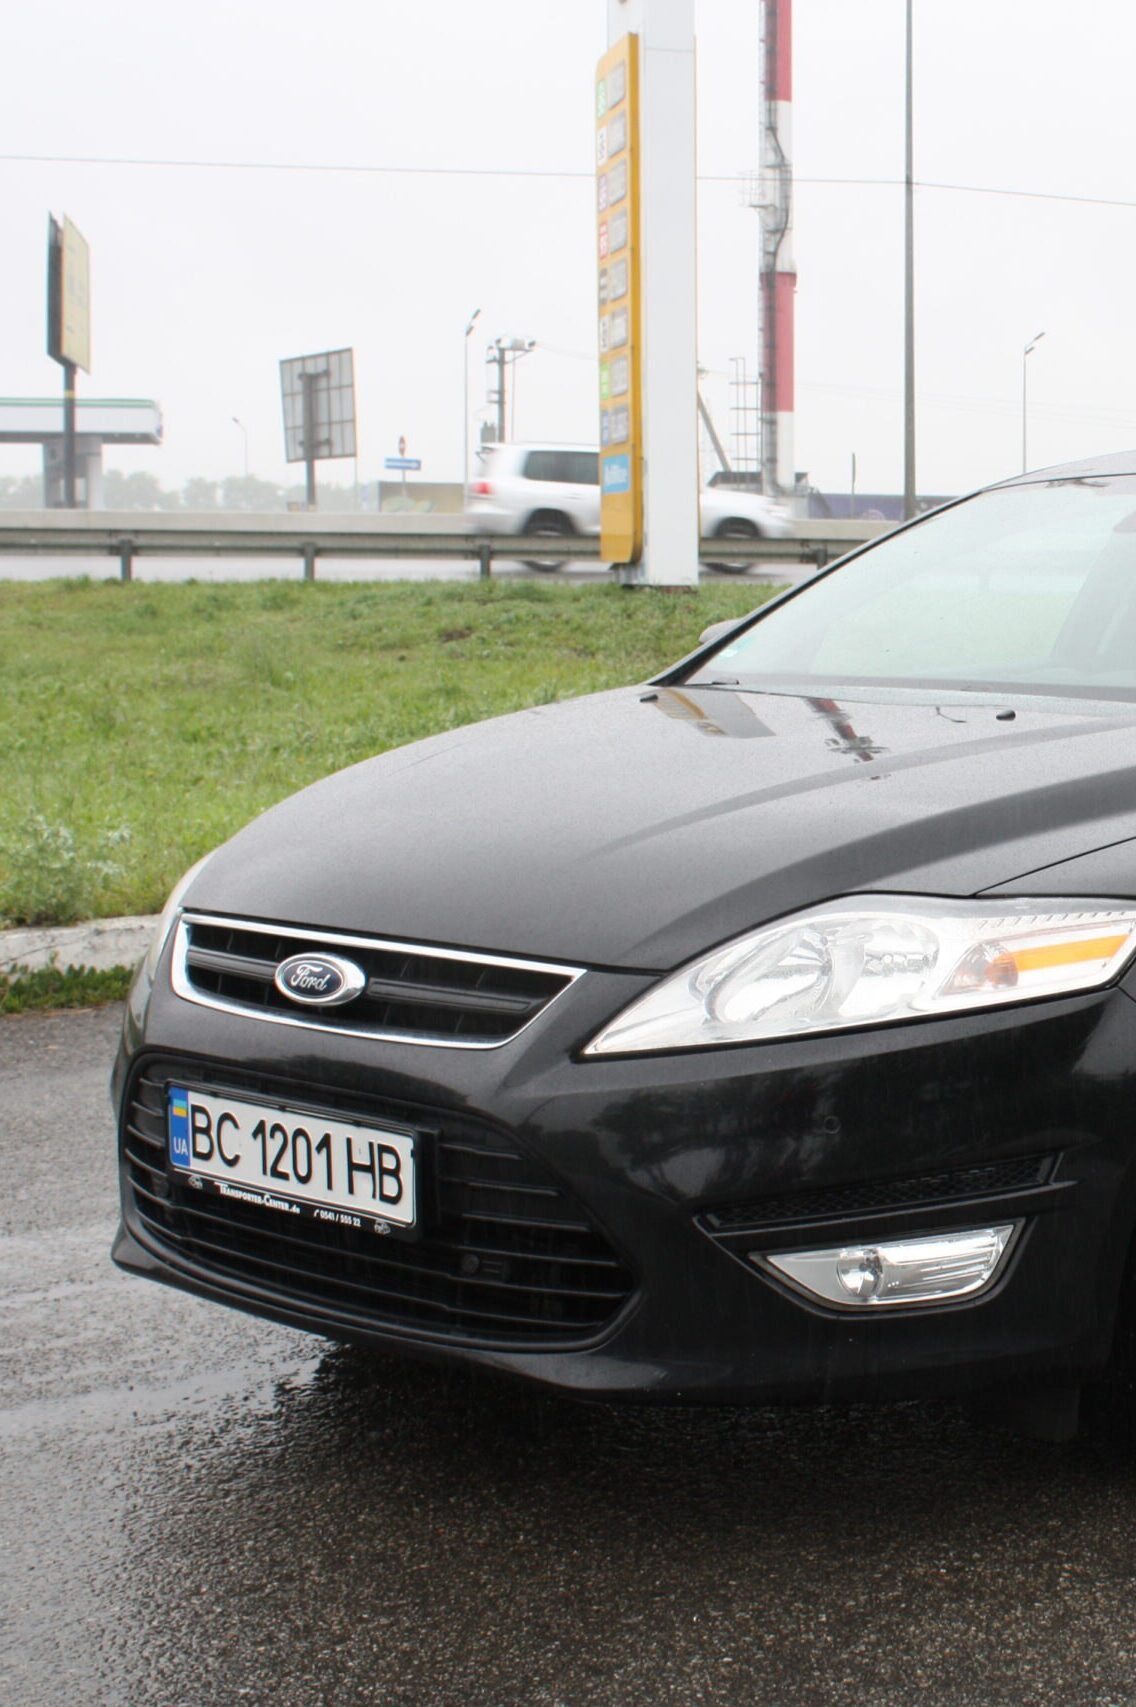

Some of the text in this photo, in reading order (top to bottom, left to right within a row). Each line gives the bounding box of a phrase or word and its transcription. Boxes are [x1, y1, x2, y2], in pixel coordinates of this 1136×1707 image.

[291, 964, 331, 991] Ford
[173, 1136, 189, 1157] UA
[190, 1104, 404, 1206] BC 1201 HB
